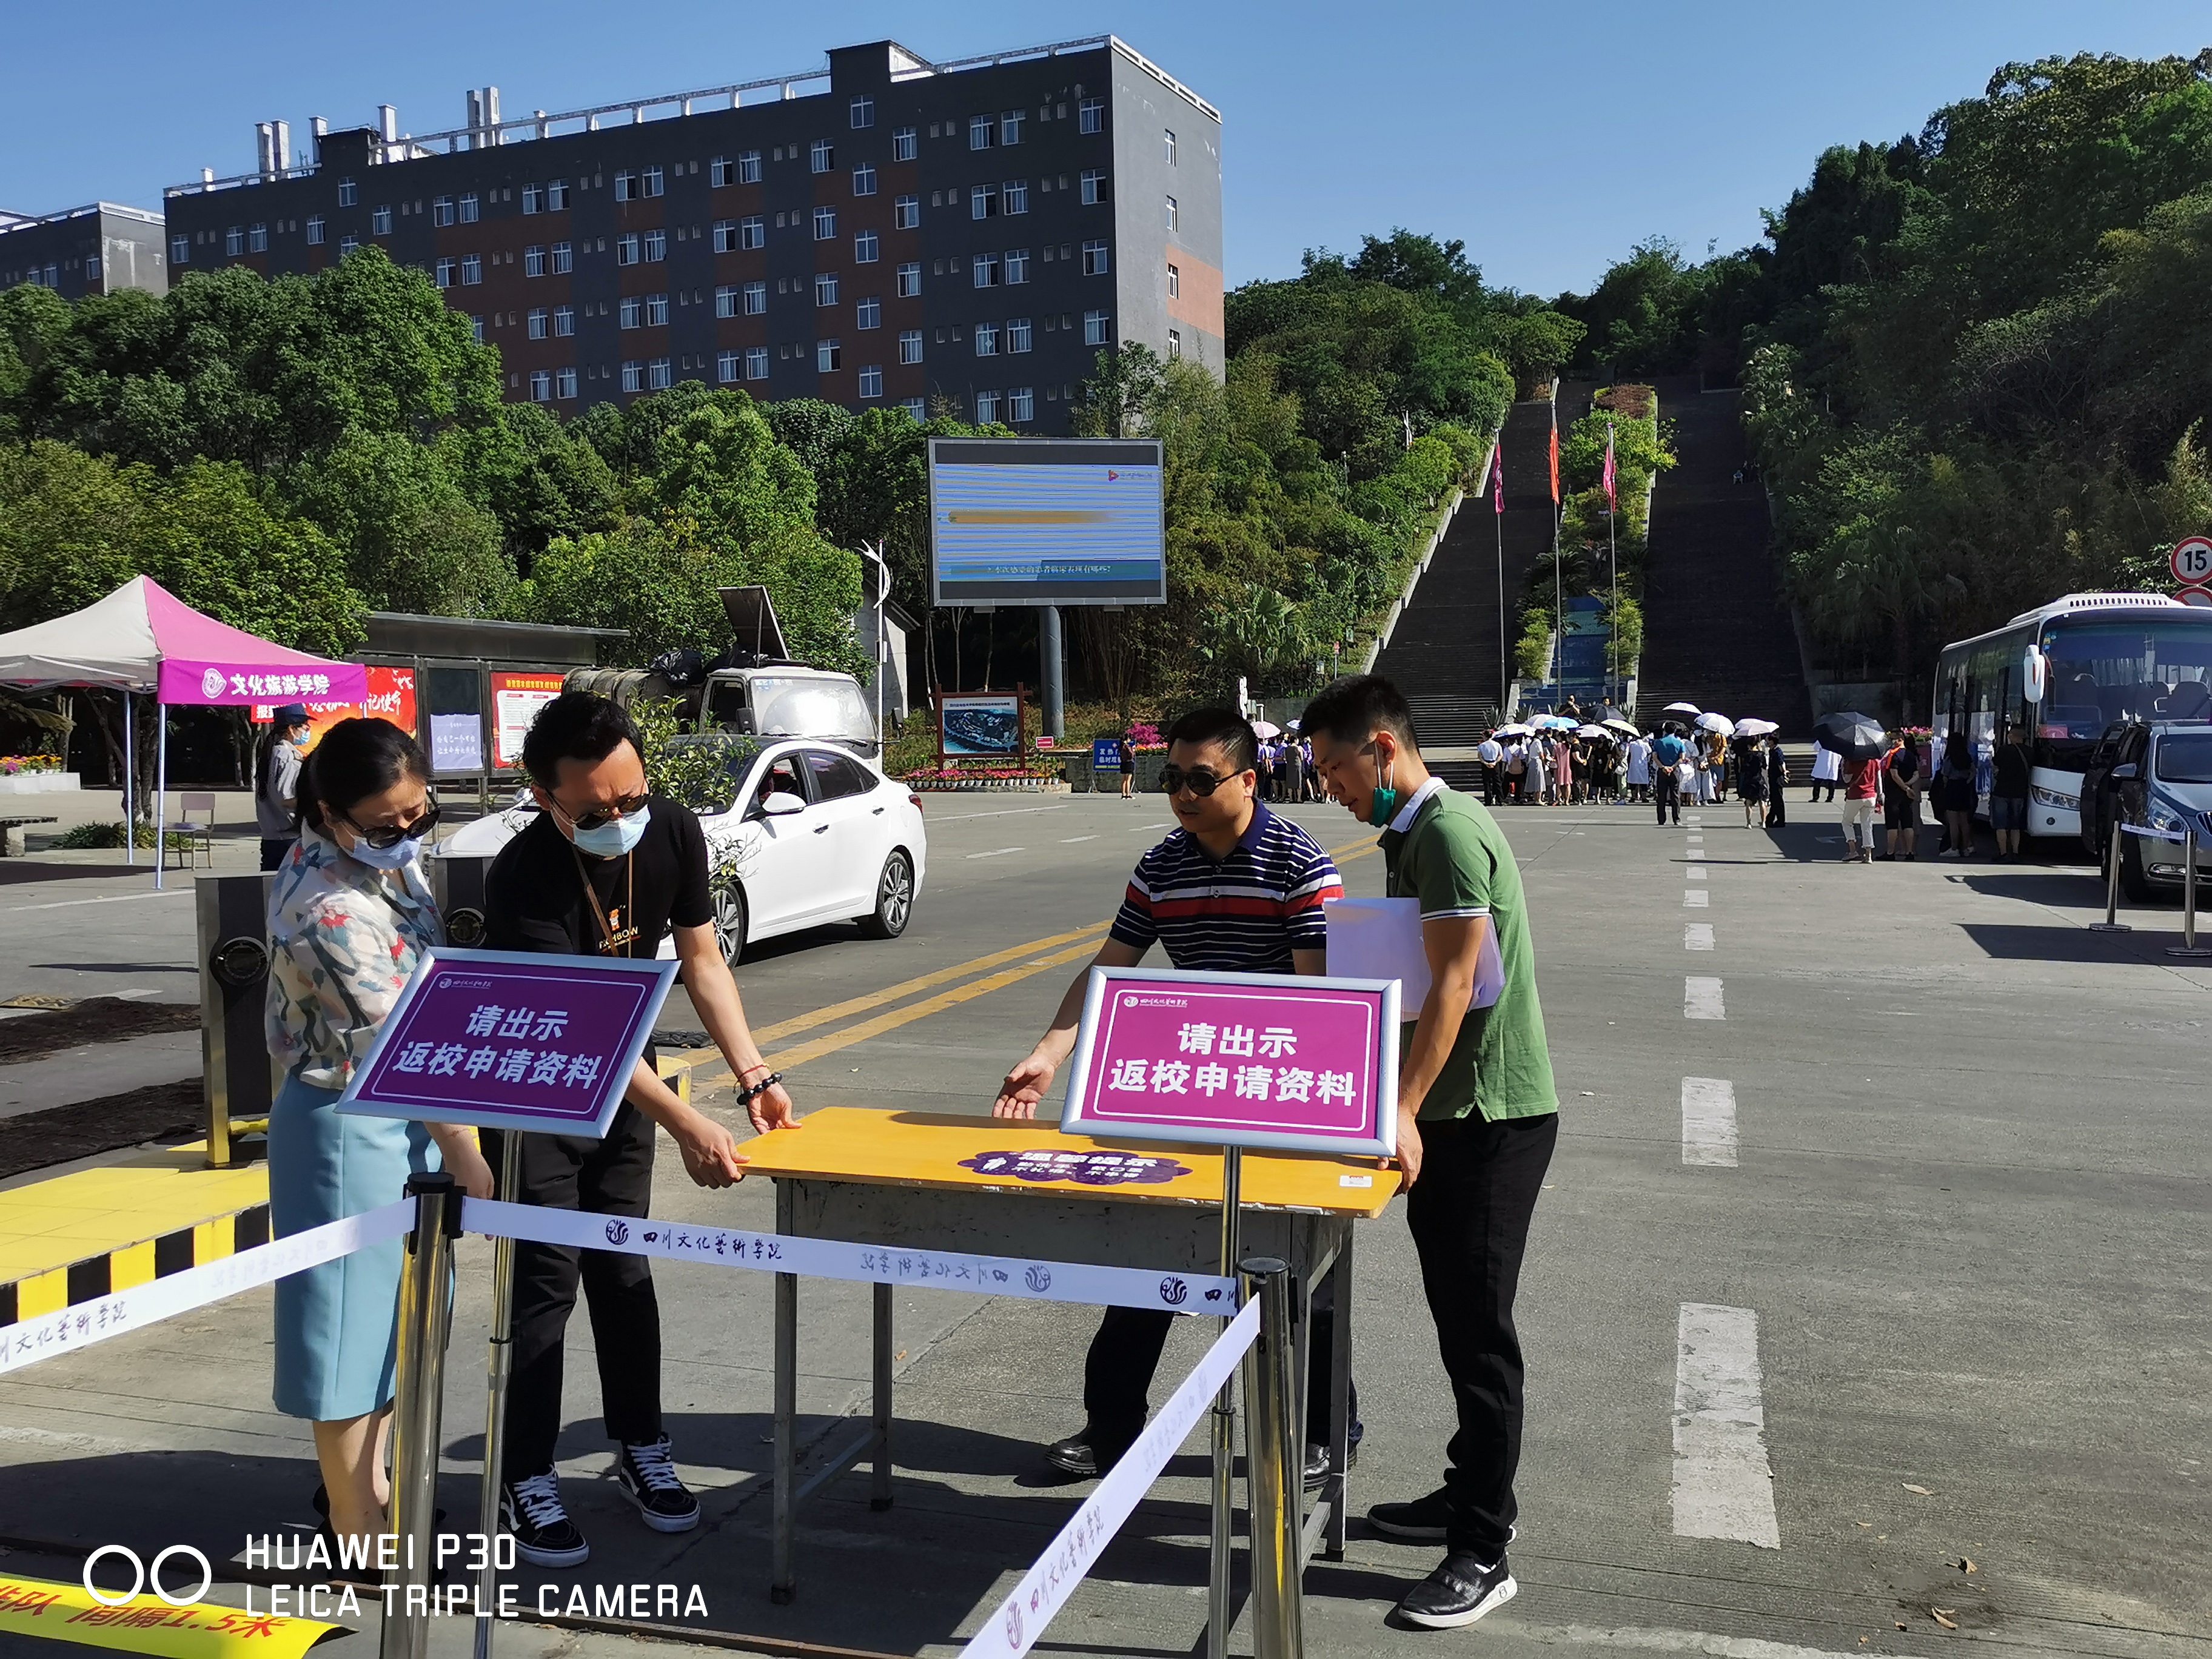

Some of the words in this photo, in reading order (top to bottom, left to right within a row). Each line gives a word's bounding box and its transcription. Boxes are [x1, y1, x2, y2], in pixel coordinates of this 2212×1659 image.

[2185, 549, 2207, 571] 15
[230, 673, 330, 696] 文化旅游学院
[464, 1005, 569, 1042] 请出示
[1178, 1022, 1298, 1057] 请出示
[392, 1040, 603, 1090] 返校申请资料
[1108, 1059, 1356, 1107] 返校申请资料
[1018, 1152, 1158, 1167] 温馨提示
[65, 1604, 293, 1638] 间隔1.5米
